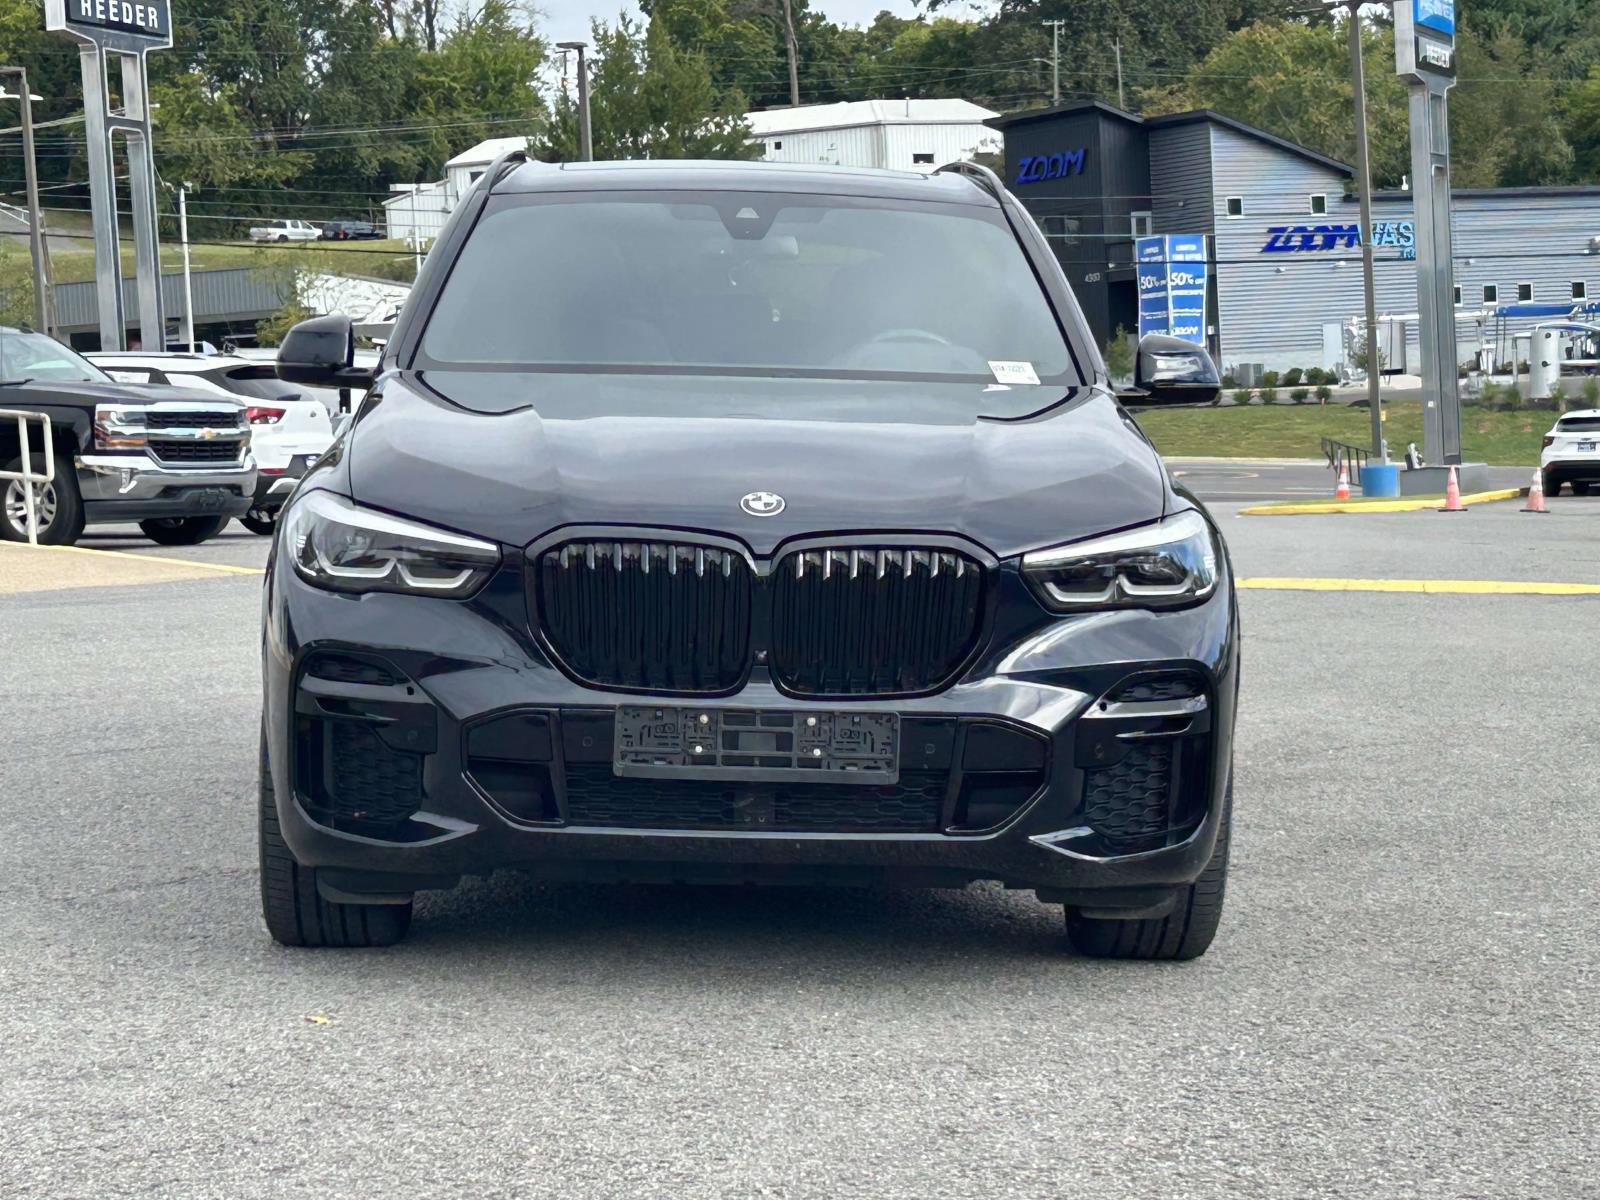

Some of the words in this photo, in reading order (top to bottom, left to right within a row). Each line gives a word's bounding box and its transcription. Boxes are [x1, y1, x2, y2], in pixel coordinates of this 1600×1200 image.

[81, 0, 159, 29] REEDER
[1015, 149, 1086, 185] ZOOM
[1170, 272, 1194, 286] 50%
